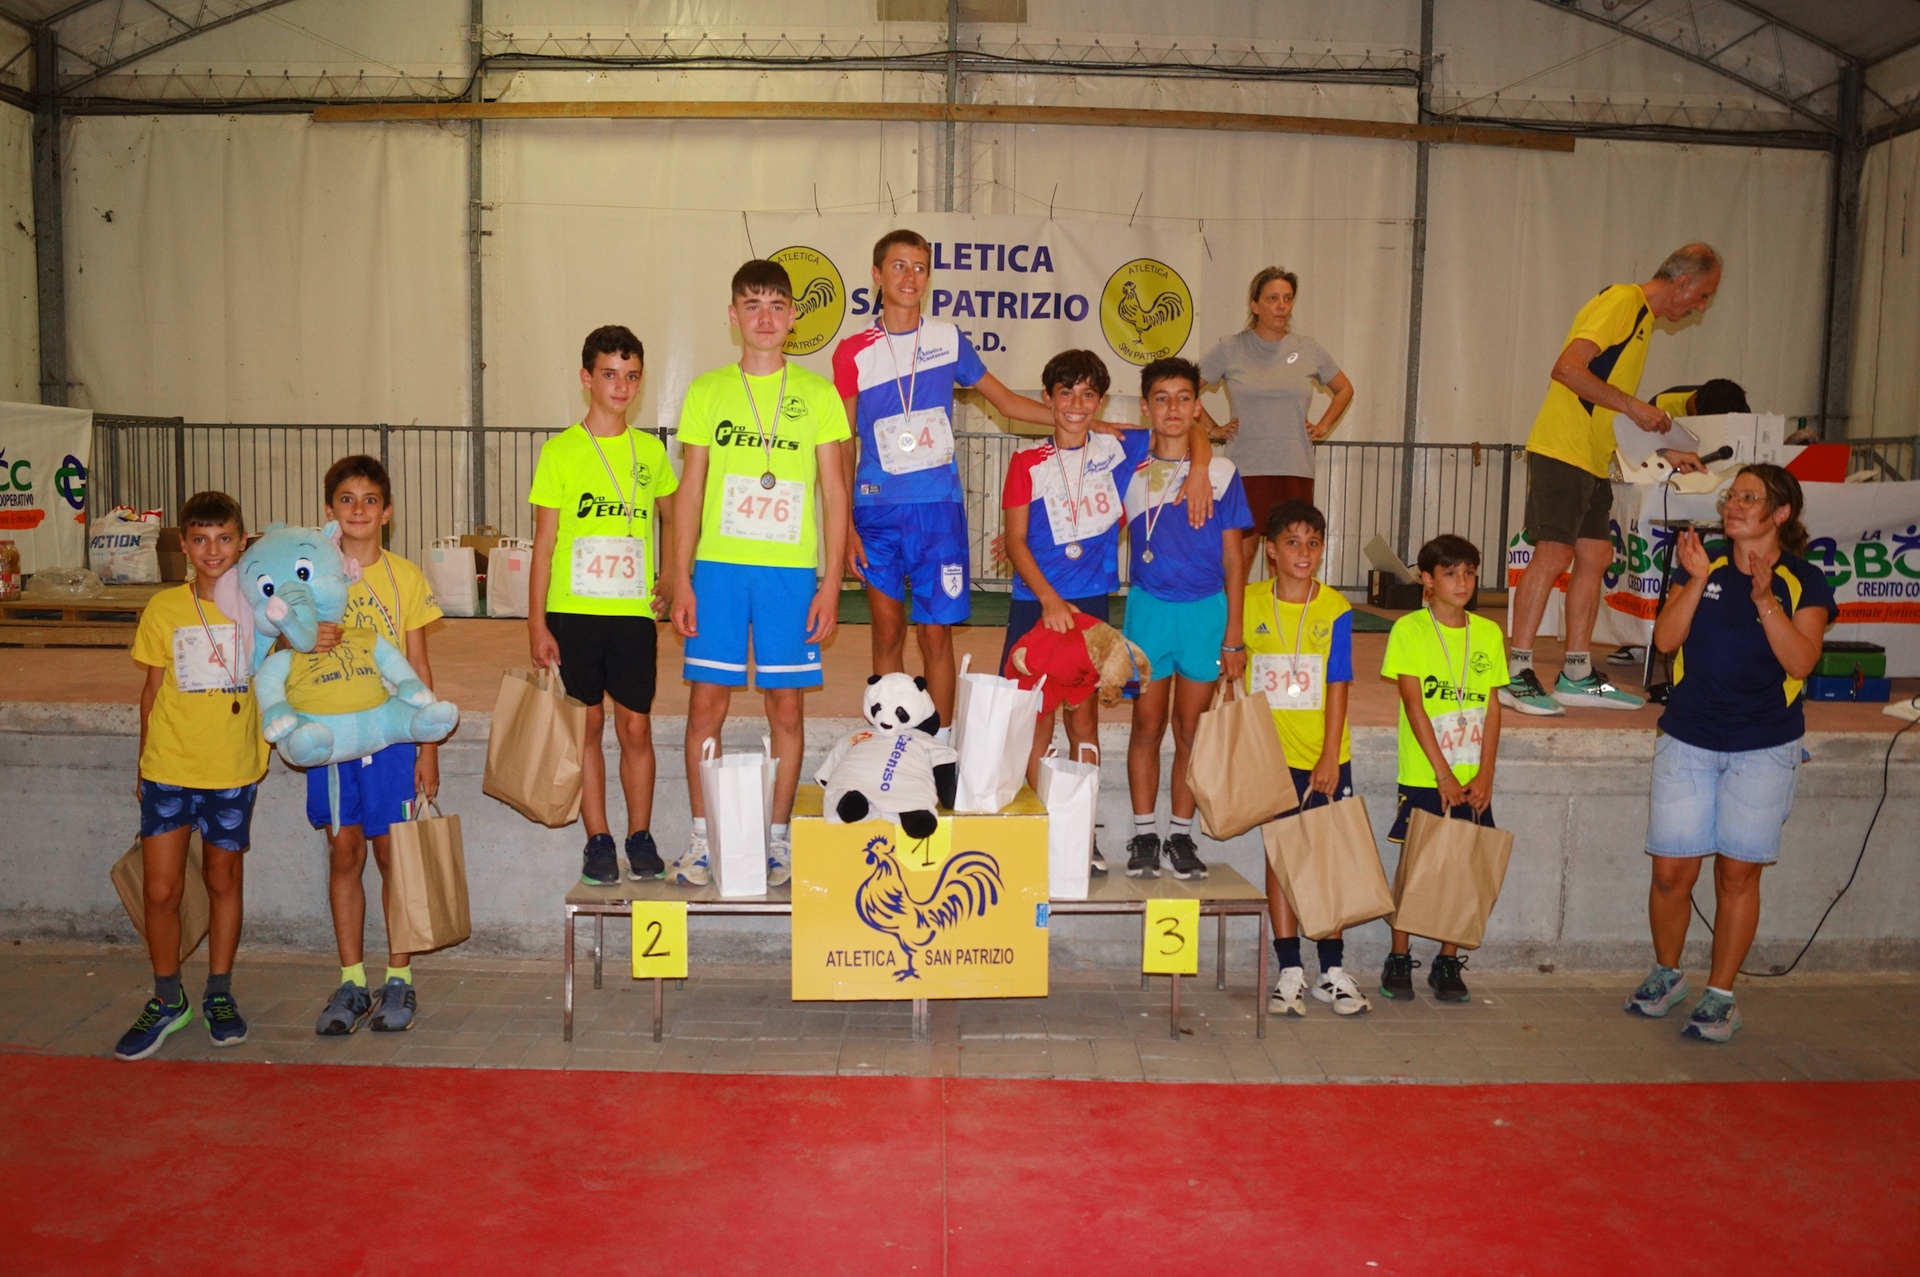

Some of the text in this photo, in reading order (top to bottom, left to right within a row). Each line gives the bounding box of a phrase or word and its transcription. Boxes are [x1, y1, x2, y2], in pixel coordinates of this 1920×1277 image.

[777, 252, 819, 265] ATLETICA
[926, 242, 1054, 273] LETICA
[1128, 264, 1169, 279] ATLETICA
[931, 289, 1090, 322] PATRIZIO
[786, 333, 825, 350] PATRIZIO
[1118, 343, 1171, 361] SAN PATRIZIO
[737, 495, 790, 522] 476
[90, 534, 141, 549] ACTION
[1861, 530, 1882, 541] LA
[586, 554, 635, 579] 473
[1628, 574, 1661, 594] CREDITO
[1857, 582, 1903, 598] CREDITO
[1264, 670, 1311, 693] 319
[1440, 724, 1482, 750] 474
[642, 920, 671, 957] 2
[1156, 917, 1185, 955] 3
[825, 950, 896, 967] ATLETICA
[924, 948, 1014, 965] SAN PATRIZIO
